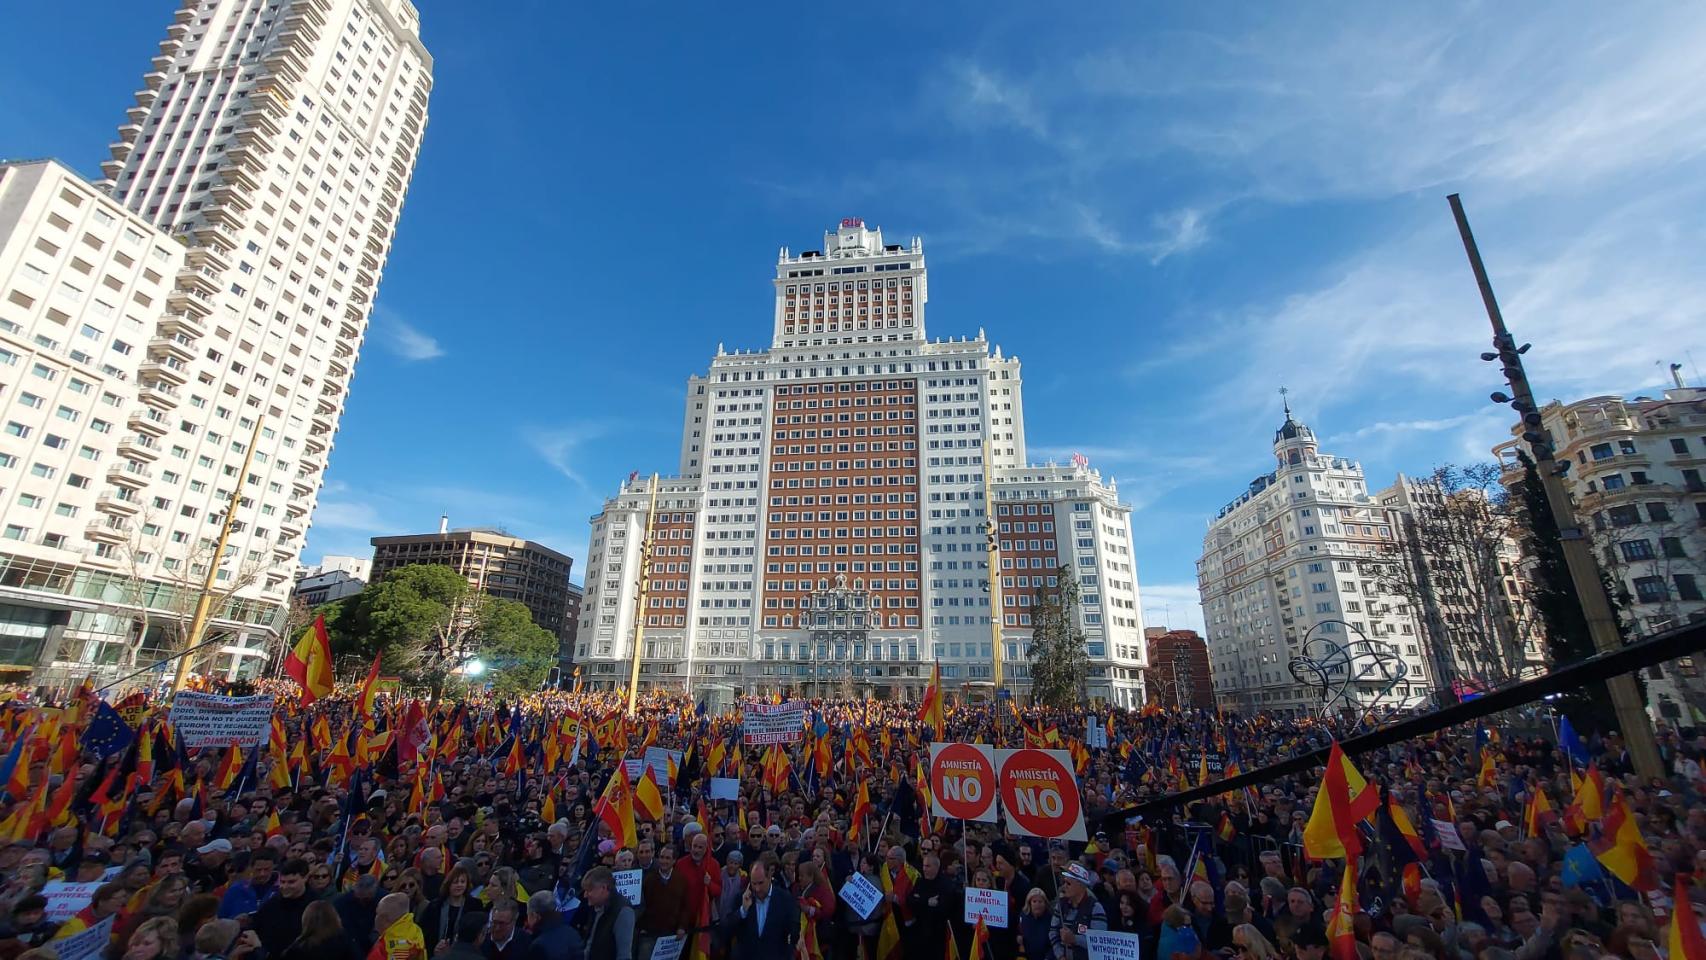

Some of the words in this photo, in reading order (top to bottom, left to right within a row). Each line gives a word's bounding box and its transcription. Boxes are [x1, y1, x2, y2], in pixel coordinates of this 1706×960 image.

[249, 701, 272, 709] ODIO
[752, 733, 788, 743] ELECCIONES
[940, 759, 982, 771] AMNISTÍA
[1009, 768, 1060, 781] AMNISTÍA
[943, 775, 982, 803] NO
[1014, 787, 1064, 818] NO
[1090, 936, 1098, 944] NO
[1099, 936, 1136, 949] DEMOCRACY
[1092, 944, 1119, 955] WITHOUT
[1120, 948, 1135, 959] RULE
